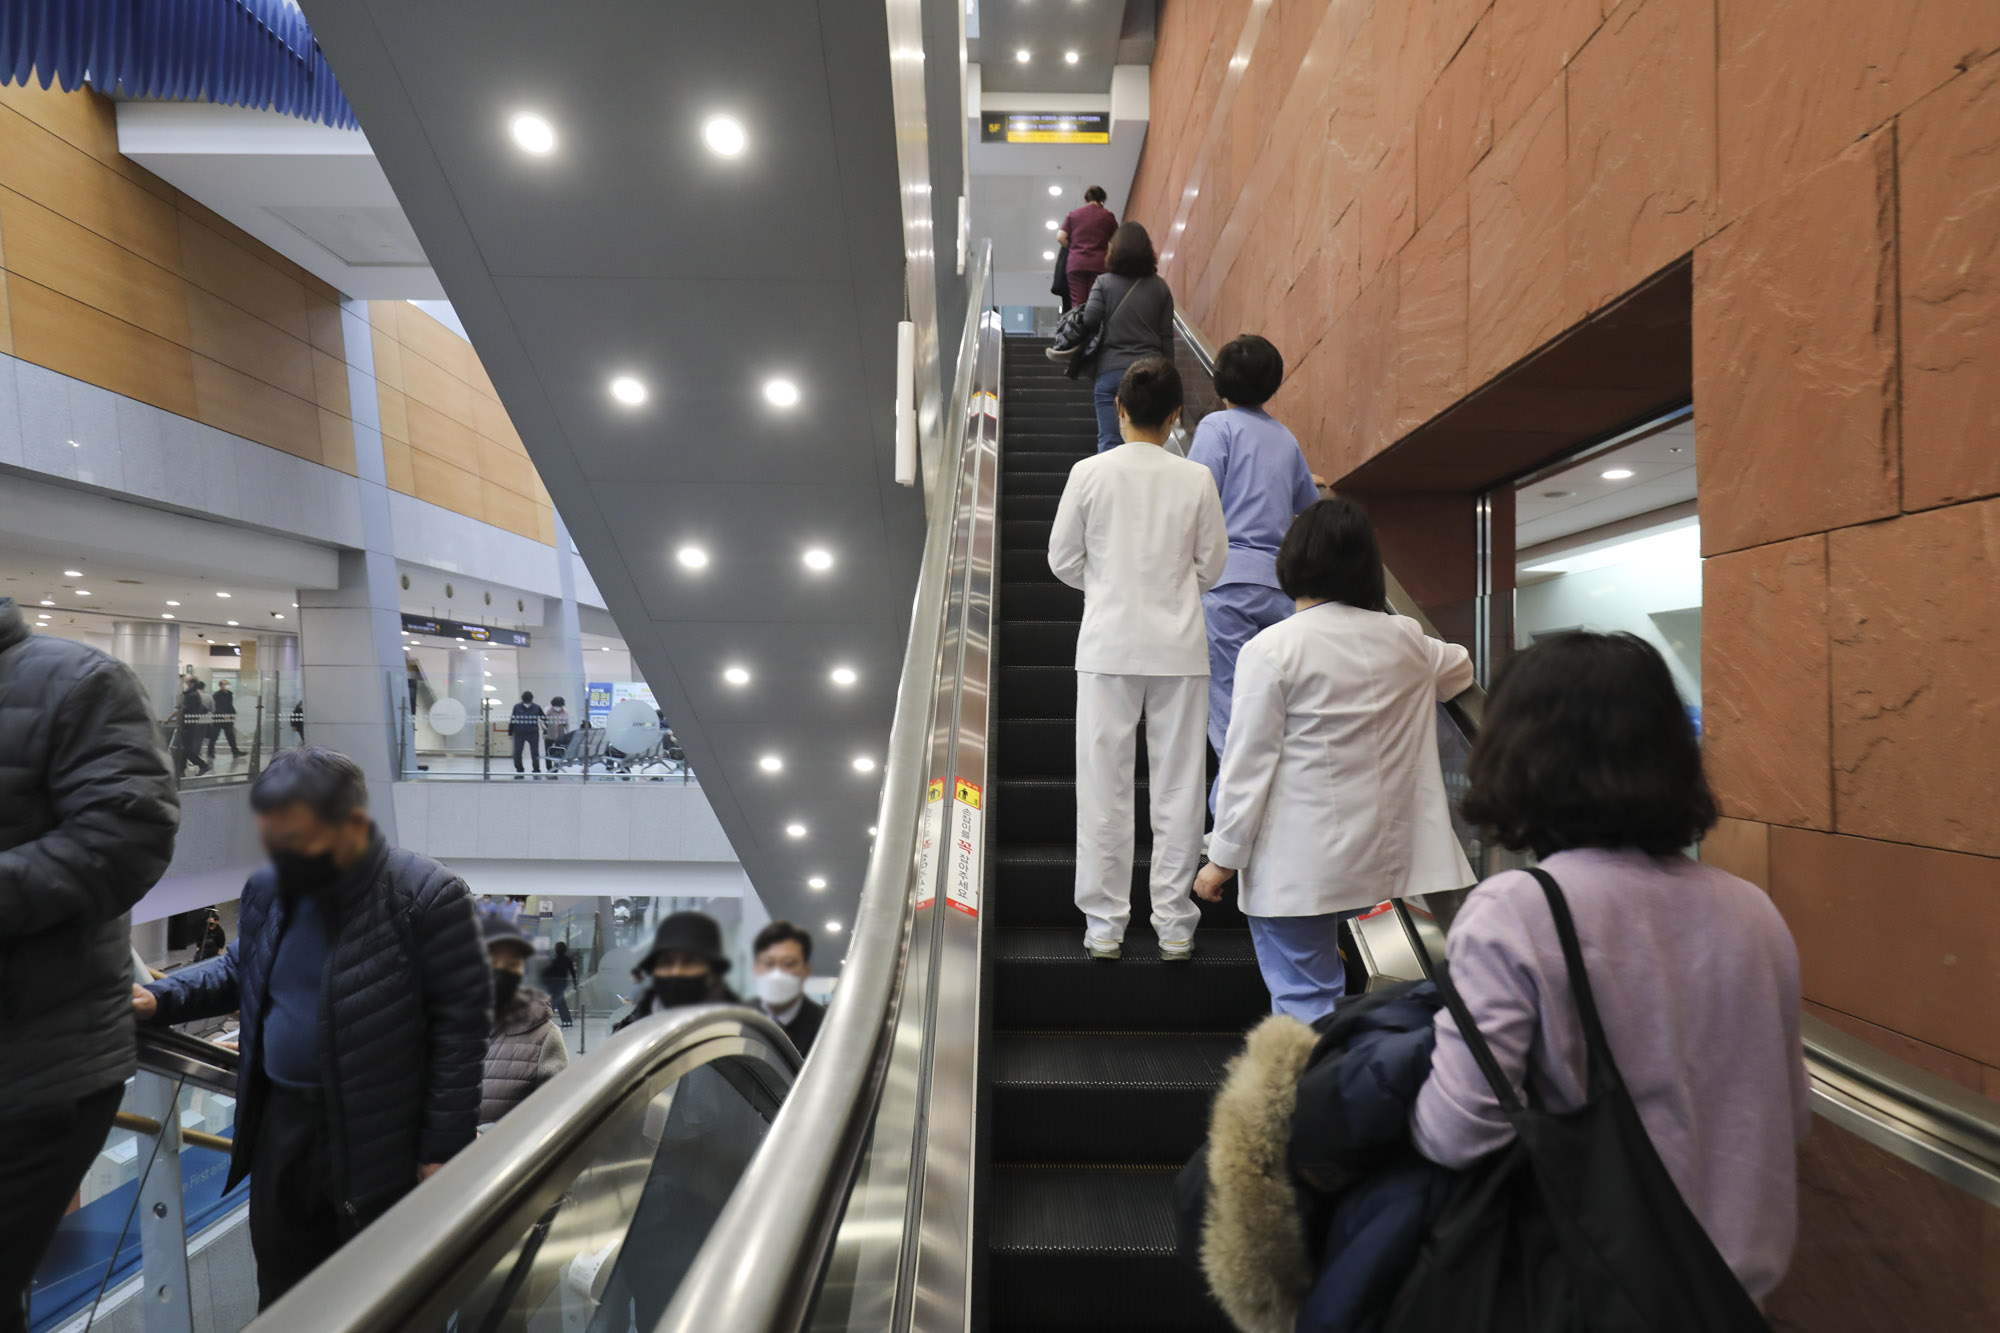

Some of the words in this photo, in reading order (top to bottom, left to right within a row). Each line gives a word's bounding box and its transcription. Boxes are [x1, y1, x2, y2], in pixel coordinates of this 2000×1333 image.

[961, 808, 972, 840] 손잡이를
[957, 839, 973, 855] 꼭
[957, 854, 970, 900] 잡아주세요
[190, 1168, 209, 1189] First
[210, 1157, 227, 1177] and
